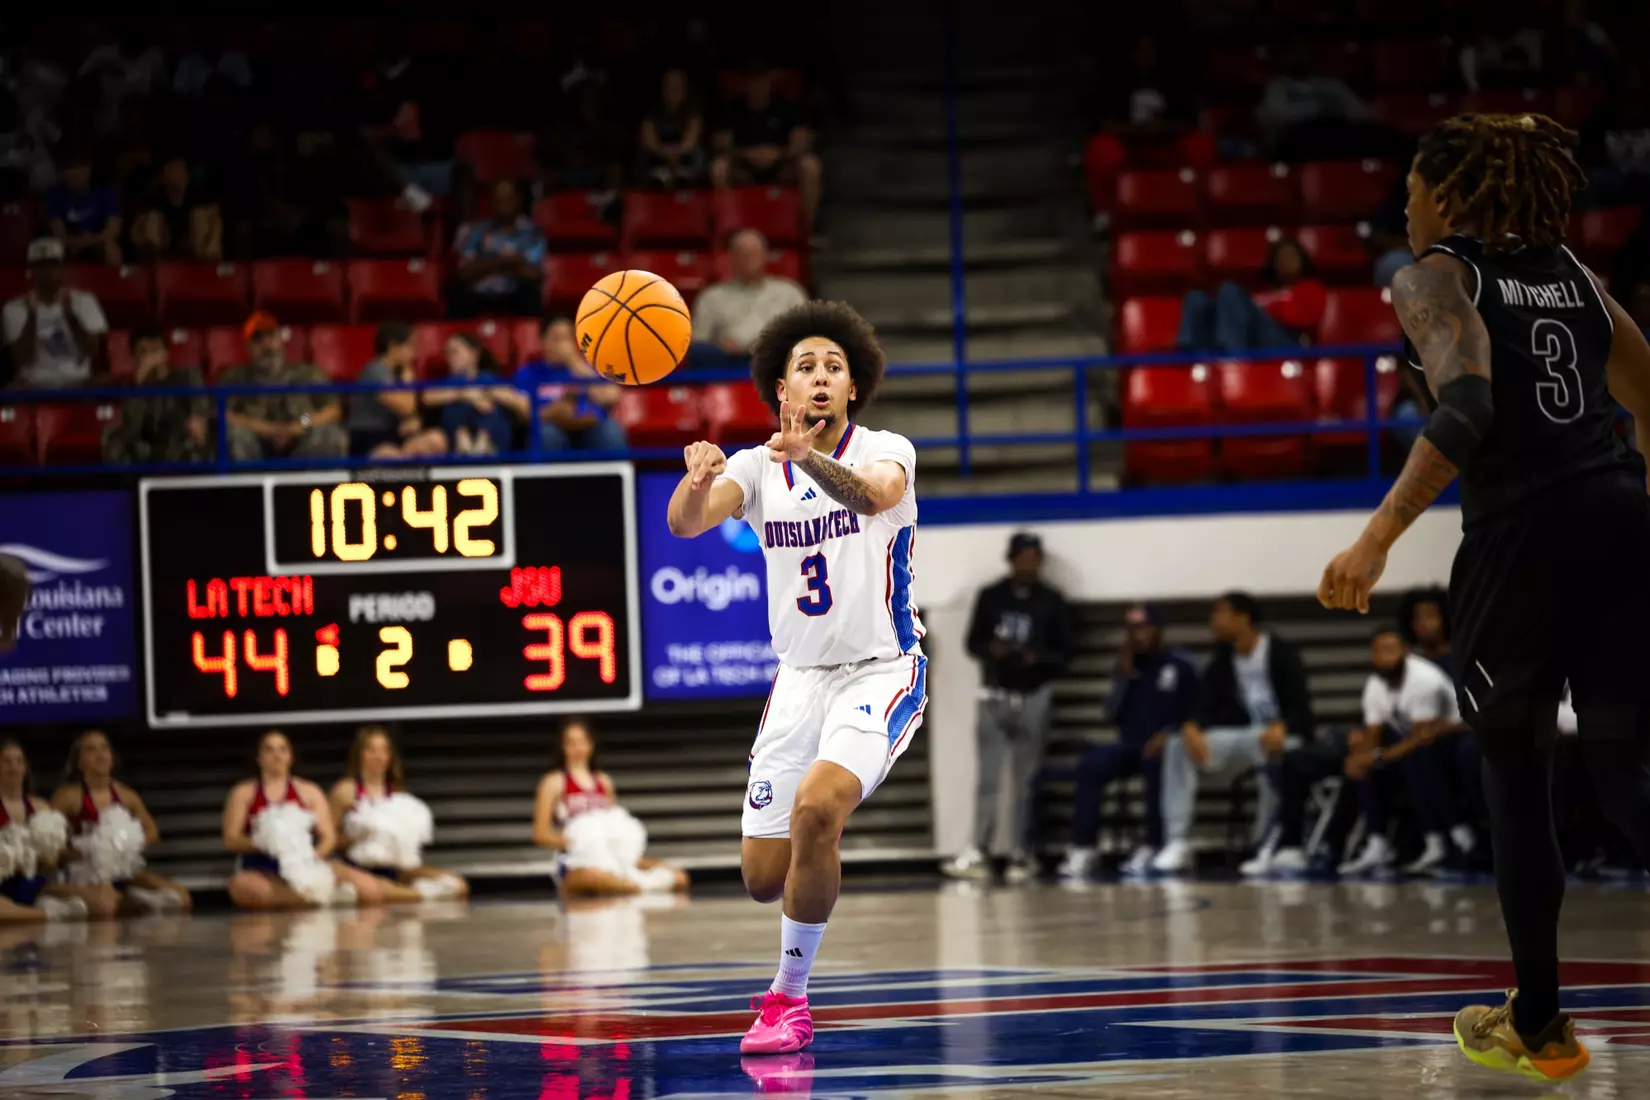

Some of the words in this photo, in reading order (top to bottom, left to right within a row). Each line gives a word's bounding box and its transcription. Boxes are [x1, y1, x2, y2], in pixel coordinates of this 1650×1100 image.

[1497, 278, 1585, 309] MITCHELL
[1531, 318, 1585, 424] 3
[310, 478, 499, 562] 10:42
[764, 516, 828, 549] OUISIAN
[348, 591, 435, 623] PERIOD
[651, 565, 760, 611] Origin
[796, 551, 834, 617] 3
[25, 611, 105, 640] Center
[521, 610, 616, 691] 39
[703, 641, 779, 665] OFFICIA
[192, 627, 290, 698] 44
[376, 625, 413, 690] 2
